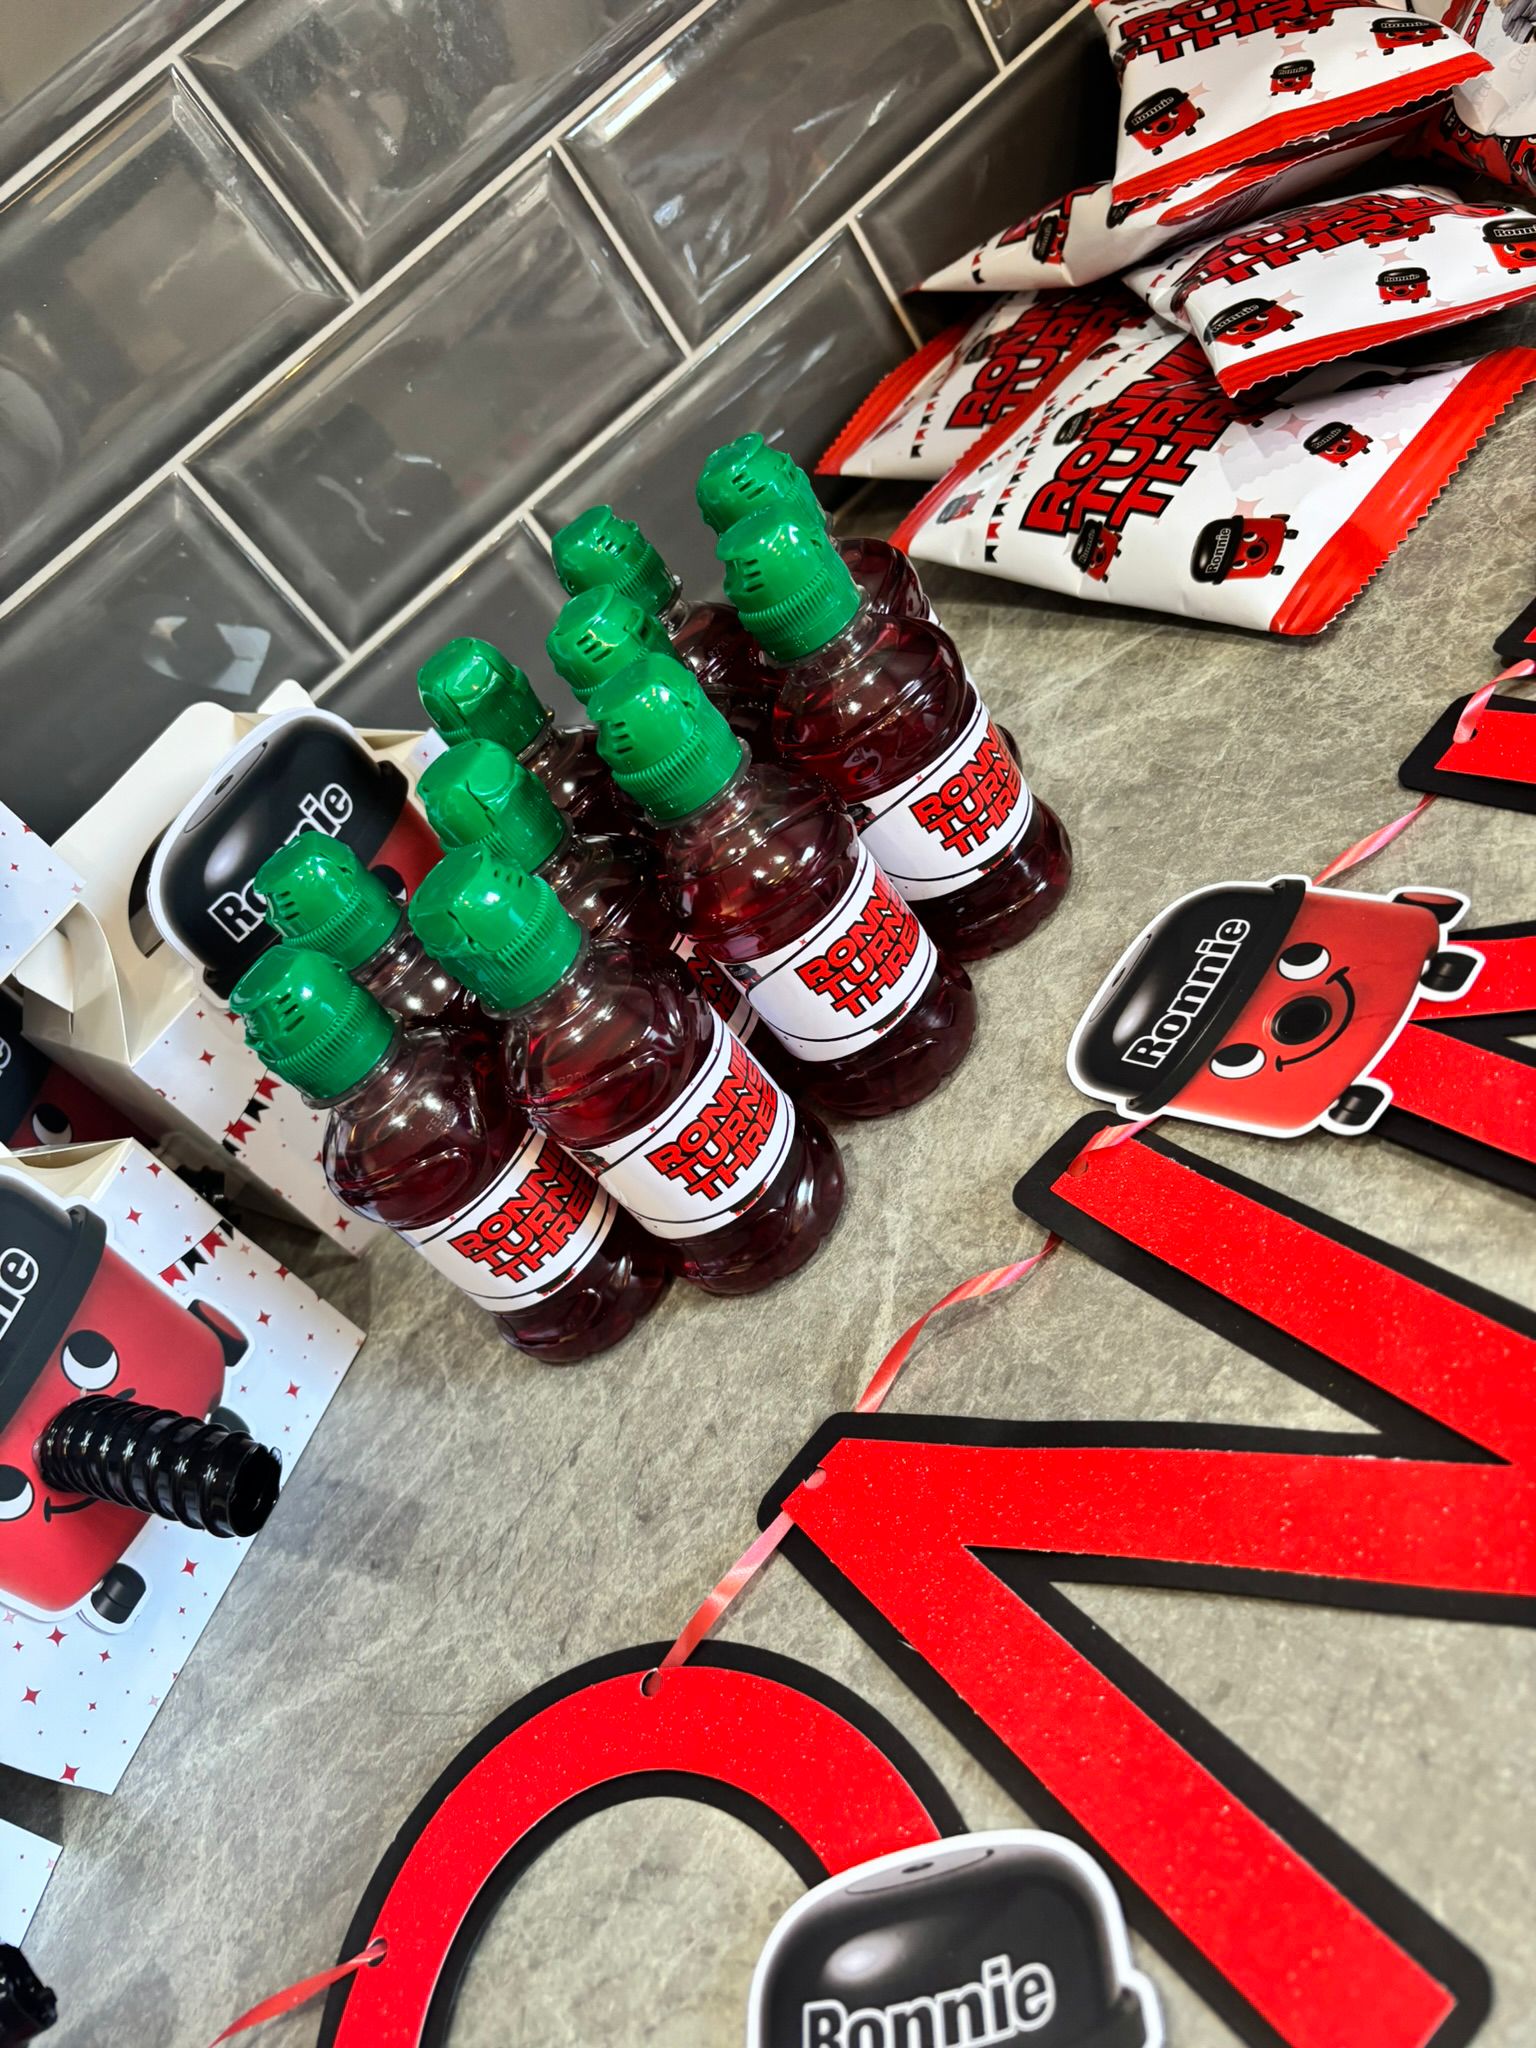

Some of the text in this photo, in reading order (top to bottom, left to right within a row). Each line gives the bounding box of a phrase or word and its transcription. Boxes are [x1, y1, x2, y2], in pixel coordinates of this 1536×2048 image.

[1131, 97, 1175, 126] Ronnie
[1204, 527, 1232, 574] Ronnie
[1121, 919, 1250, 1069] Ronnie
[644, 1033, 748, 1175] RONNIE
[666, 1058, 763, 1184] TURNS
[684, 1075, 778, 1201] THREE
[803, 1953, 1055, 2048] Ronnie
